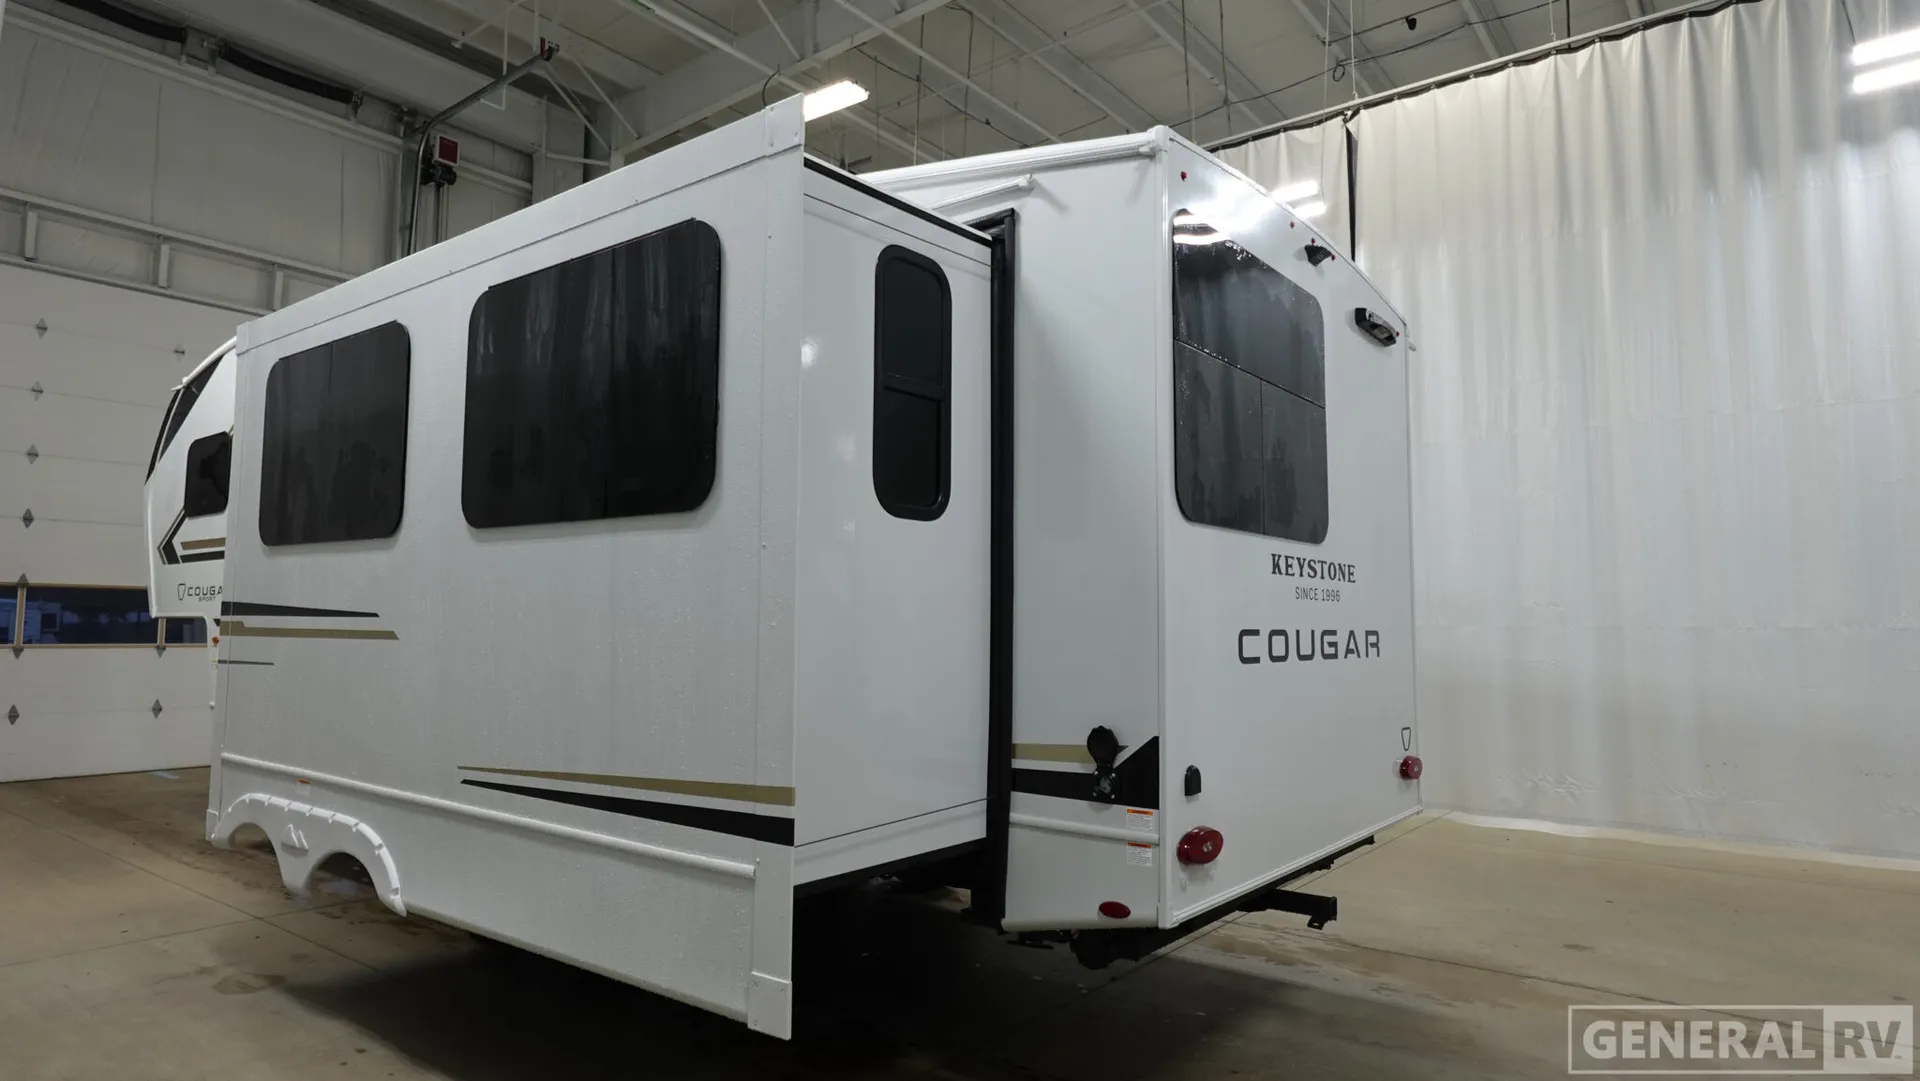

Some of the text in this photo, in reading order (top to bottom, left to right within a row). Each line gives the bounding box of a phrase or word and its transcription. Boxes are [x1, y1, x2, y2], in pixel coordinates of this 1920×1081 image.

[1271, 553, 1356, 583] KEYSTONE
[1295, 586, 1341, 602] SINCE 1996
[1238, 629, 1380, 664] COUGAR
